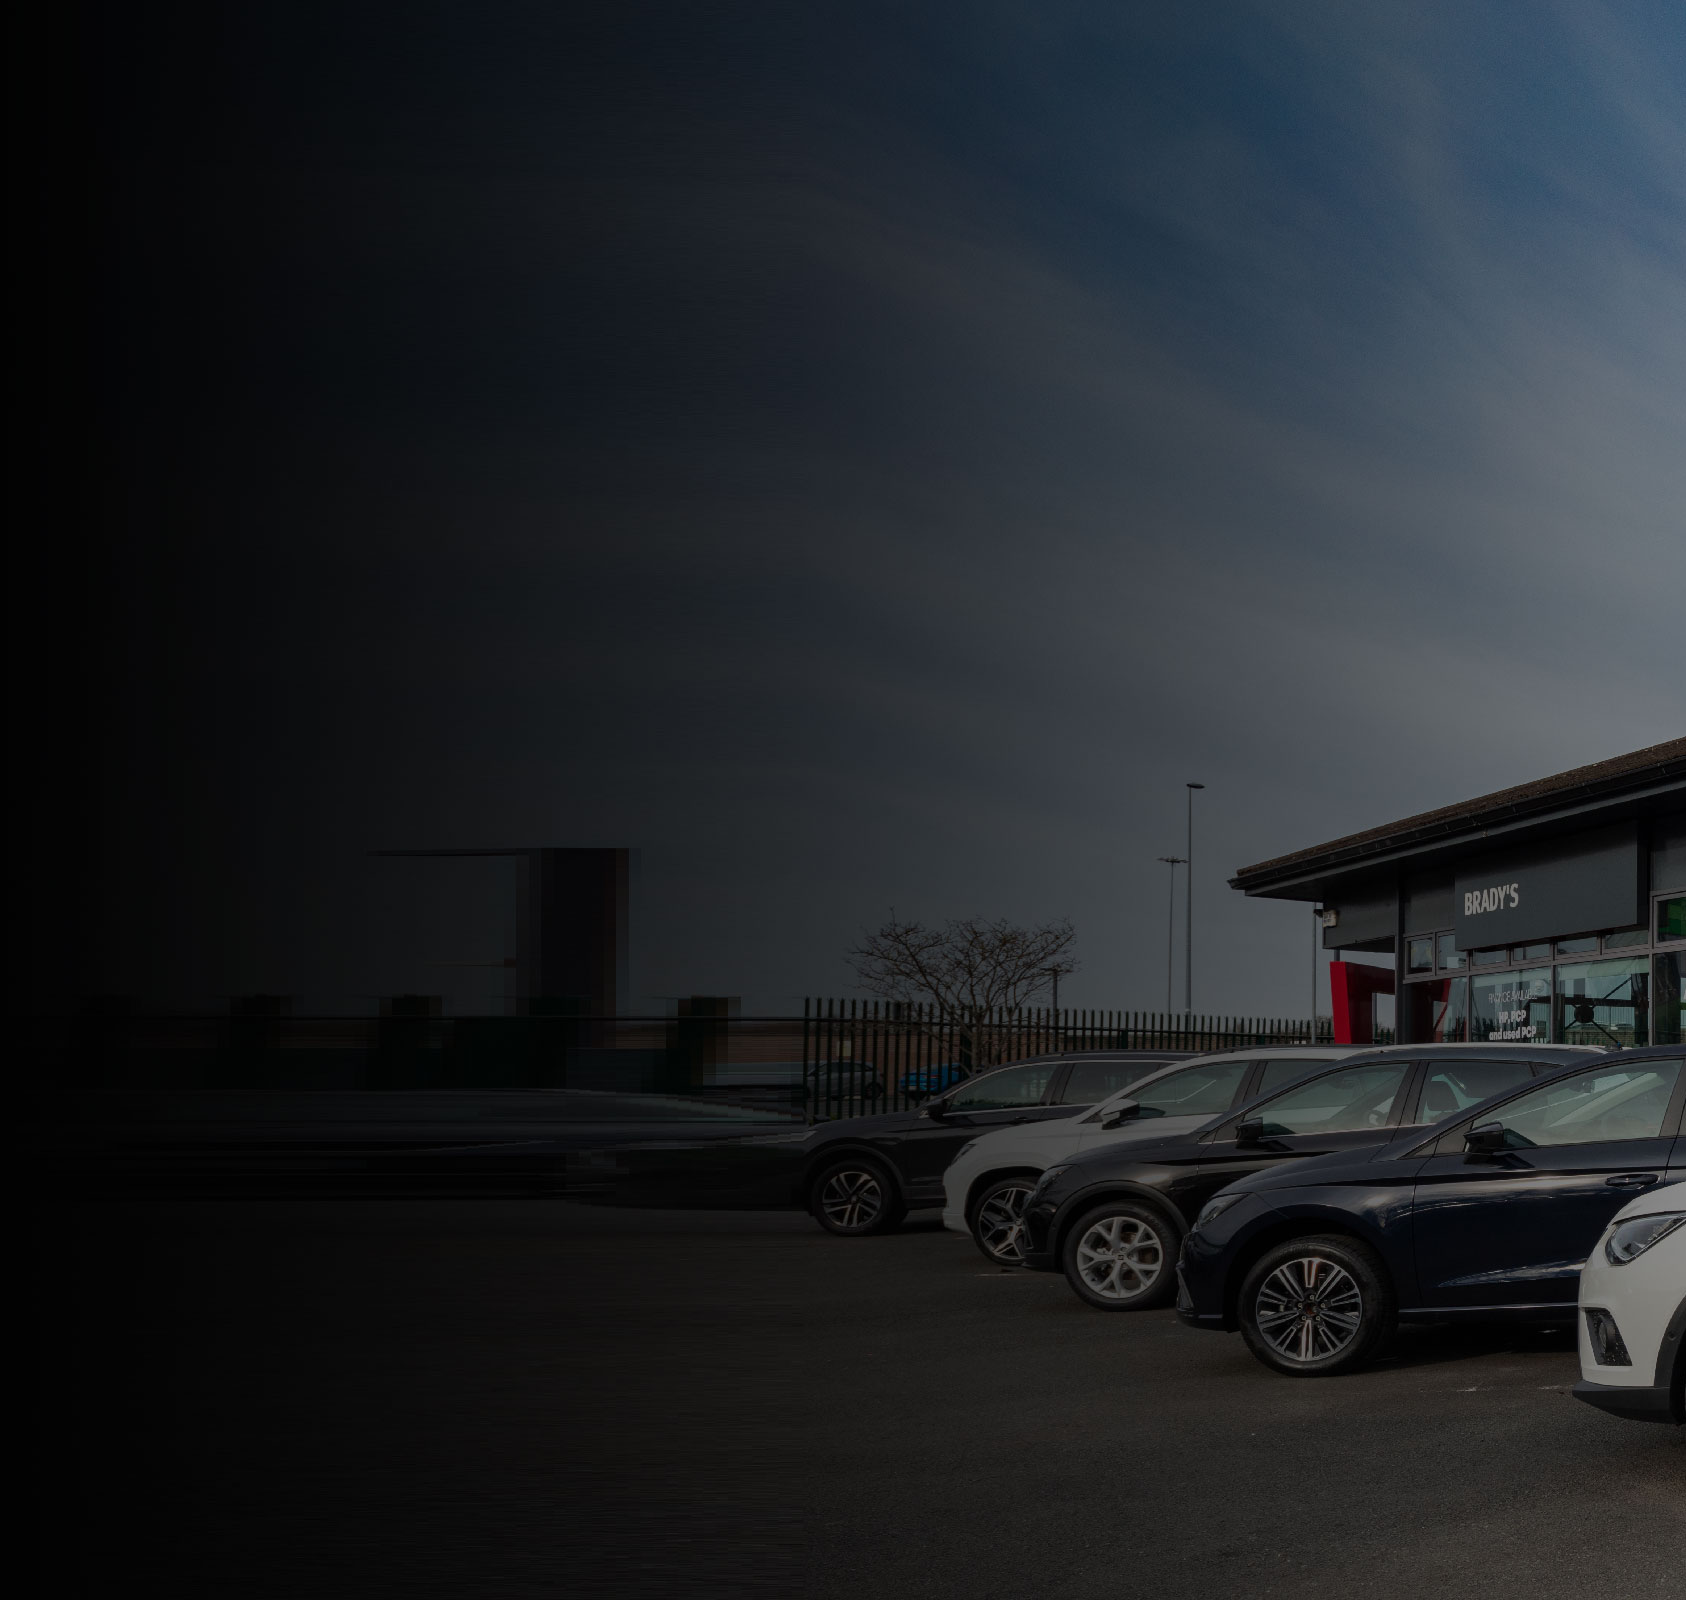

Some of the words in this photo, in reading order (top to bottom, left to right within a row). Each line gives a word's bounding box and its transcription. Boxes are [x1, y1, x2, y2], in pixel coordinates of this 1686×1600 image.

[1464, 882, 1519, 916] BRADY'S
[1511, 1009, 1527, 1022] PCP
[1489, 1028, 1503, 1040] and
[1503, 1027, 1521, 1040] used
[1521, 1025, 1537, 1039] PCP
